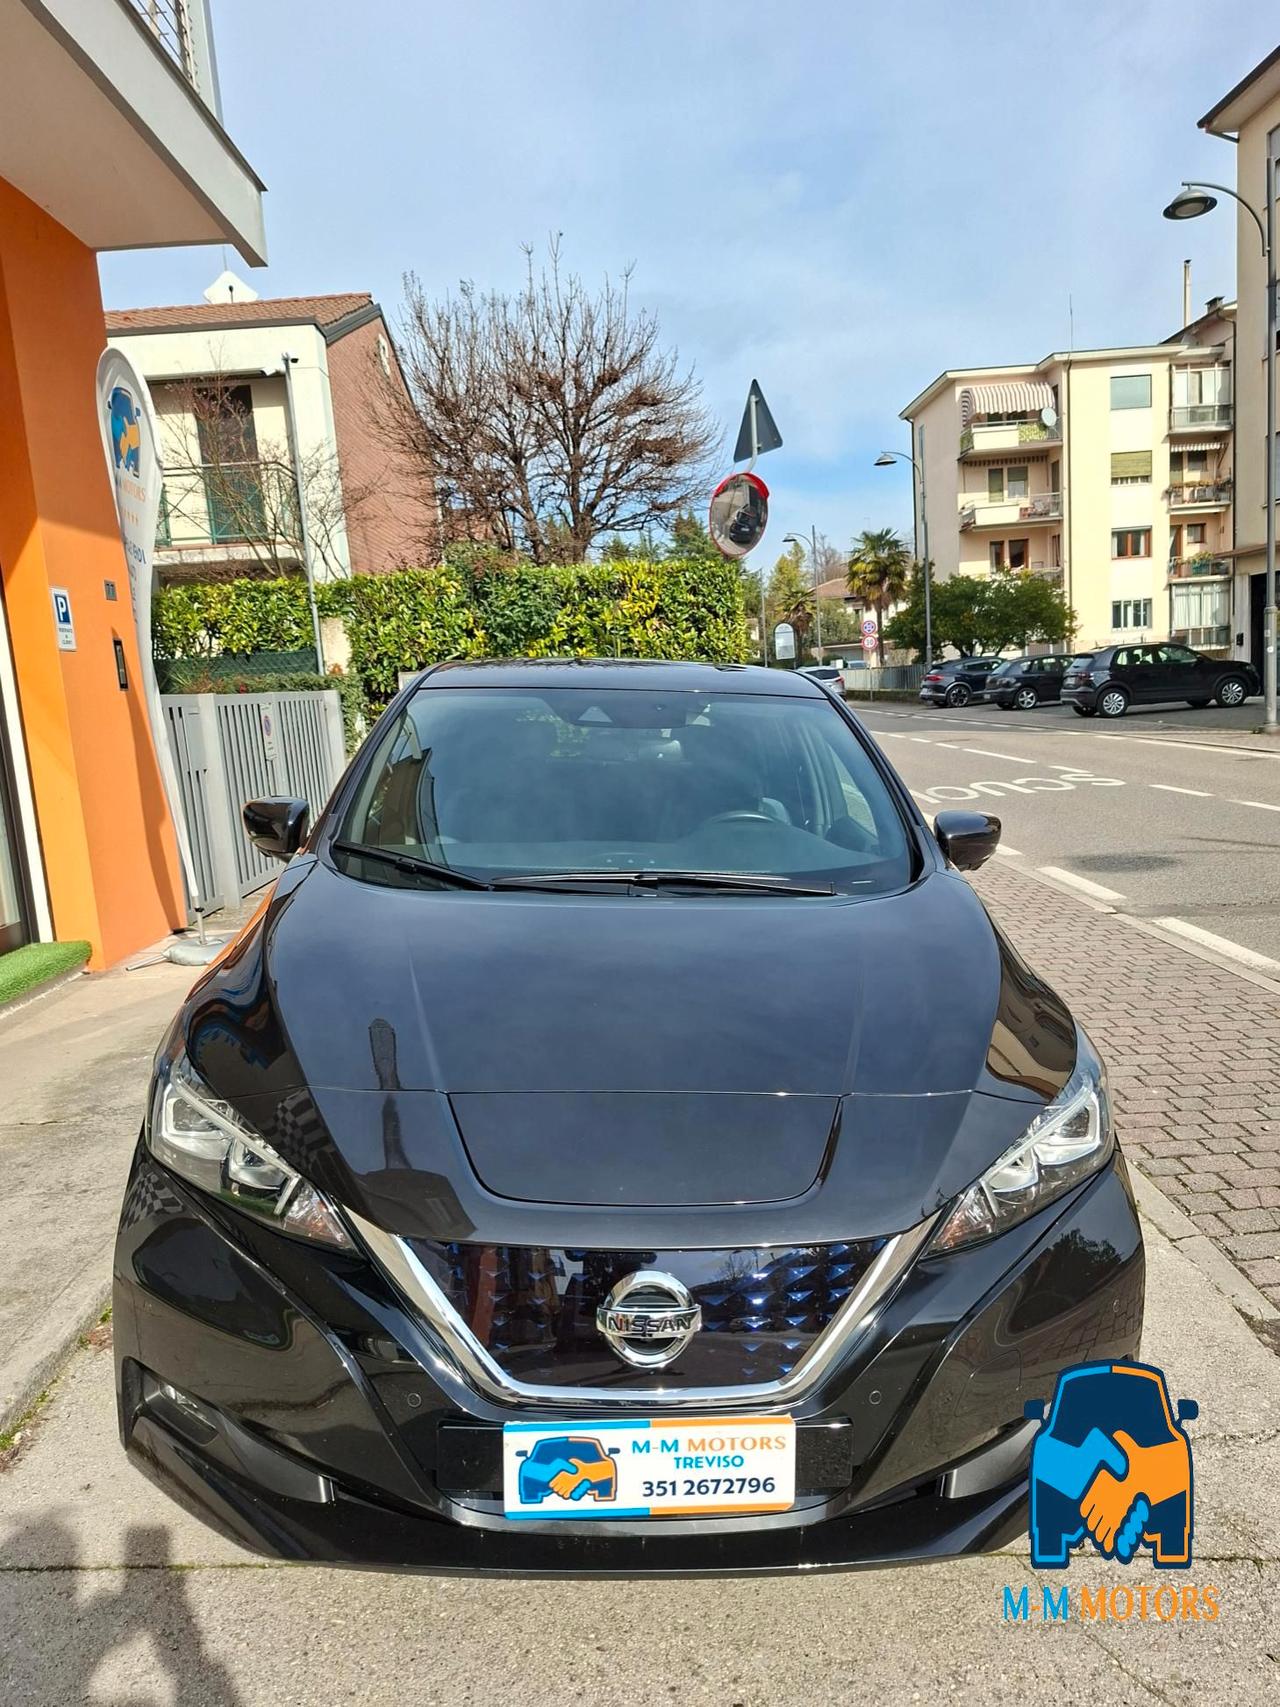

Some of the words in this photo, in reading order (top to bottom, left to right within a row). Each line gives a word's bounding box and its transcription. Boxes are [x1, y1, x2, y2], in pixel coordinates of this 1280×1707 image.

[57, 596, 67, 622] P
[608, 1315, 693, 1333] NISSAN
[632, 1439, 679, 1454] M-M
[687, 1436, 786, 1452] MOTORS
[674, 1455, 744, 1469] TREVISO
[642, 1480, 677, 1497] 351
[683, 1477, 775, 1496] 2672796
